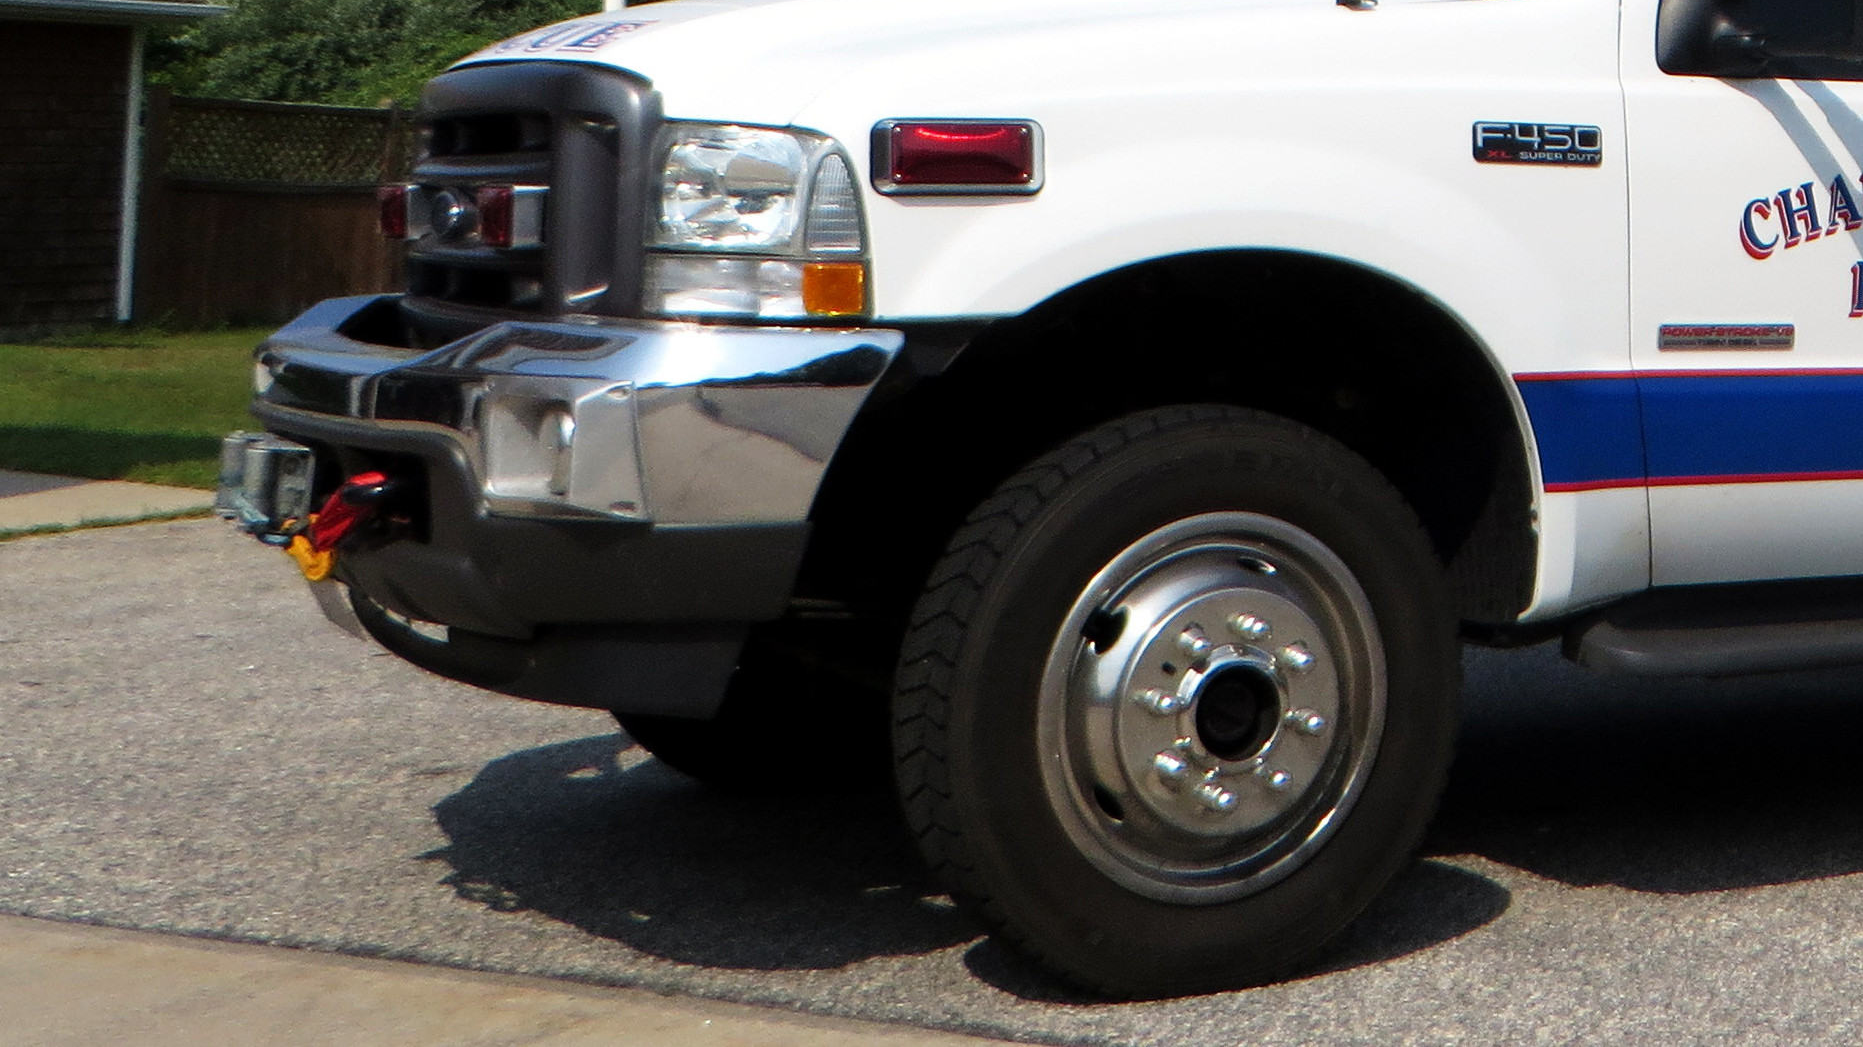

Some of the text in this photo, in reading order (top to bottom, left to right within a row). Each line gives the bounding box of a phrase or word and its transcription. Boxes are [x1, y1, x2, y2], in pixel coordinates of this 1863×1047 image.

[1476, 123, 1601, 150] F-450
[1520, 151, 1563, 160] SUPER
[1567, 153, 1601, 162] DUTY
